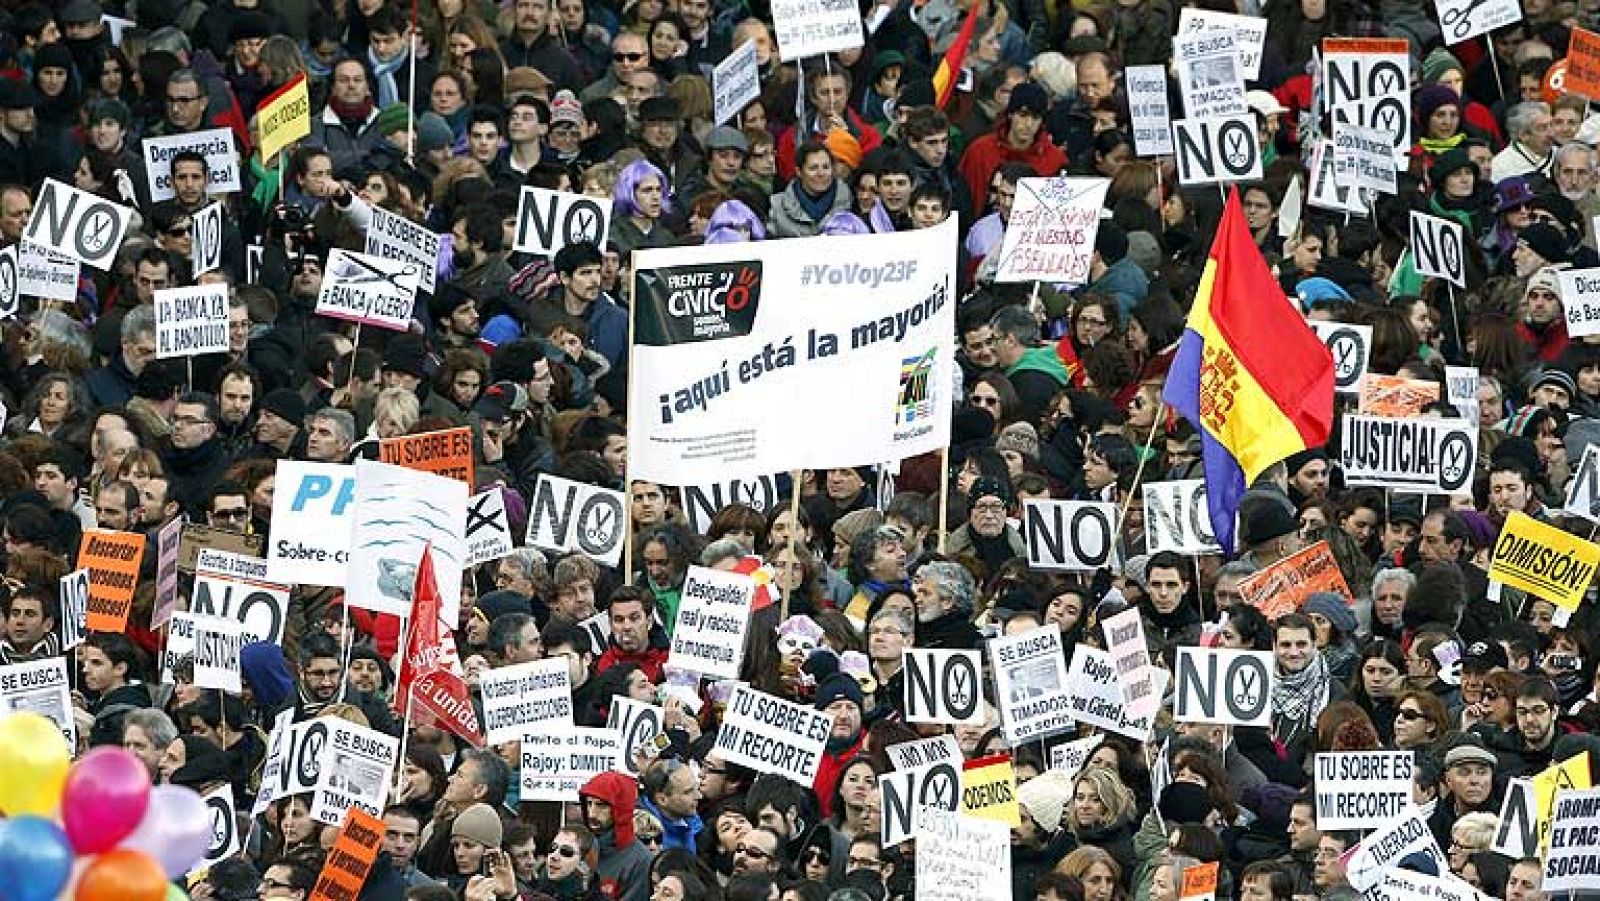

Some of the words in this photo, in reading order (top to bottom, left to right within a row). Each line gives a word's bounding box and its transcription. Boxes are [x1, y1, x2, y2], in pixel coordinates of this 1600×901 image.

[1198, 37, 1234, 53] BUSCA
[1190, 87, 1242, 105] TIMADOR
[1327, 60, 1405, 105] NO
[150, 138, 228, 163] Democracia
[1177, 120, 1256, 180] NO
[155, 166, 234, 189] ecica!
[28, 184, 122, 261] NO
[372, 208, 385, 231] TU
[387, 216, 422, 249] SOBRE
[425, 234, 438, 257] ES
[519, 192, 605, 250] NO
[194, 208, 220, 275] NO
[368, 236, 380, 256] MI
[1412, 216, 1461, 280] NO
[668, 273, 713, 288] FRENTE
[800, 259, 917, 288] #YoVoy23F
[331, 285, 366, 311] BANCA
[738, 336, 796, 385] está
[808, 330, 838, 359] la
[851, 274, 949, 349] mayoría!
[1569, 307, 1582, 323] de
[1327, 327, 1365, 387] O
[382, 443, 400, 464] TU
[404, 438, 448, 464] SOBRE
[450, 432, 470, 458] ES
[1343, 417, 1436, 474] JUSTICIA!
[530, 480, 624, 555] NO
[1027, 504, 1111, 566] NO
[1495, 531, 1592, 590] DIMISIÓN!
[194, 581, 282, 643] NO
[999, 647, 1012, 662] SE
[1018, 634, 1059, 658] BUSCA
[2, 674, 17, 690] SE
[21, 667, 63, 687] BUSCA
[905, 652, 978, 720] NO
[1178, 652, 1270, 720] NO
[733, 688, 755, 716] TU
[754, 697, 809, 735] SOBRE
[807, 715, 830, 743] ES
[1010, 696, 1068, 723] TIMADOR
[333, 729, 349, 747] SE
[352, 735, 394, 760] BUSCA
[567, 735, 578, 746] al
[608, 700, 658, 773] NO
[718, 723, 740, 751] MI
[1014, 725, 1032, 737] en
[523, 753, 566, 775] Rajoy:
[570, 755, 615, 771] DIMITE
[1319, 755, 1336, 780] TU
[1340, 755, 1390, 780] SOBRE
[1394, 754, 1411, 780] ES
[882, 762, 959, 844] NO
[962, 778, 1014, 811] ODEMOS.
[1319, 792, 1334, 818] MI
[1337, 792, 1407, 818] RECORTE
[320, 810, 338, 823] en
[1552, 828, 1565, 848] EL
[1568, 825, 1600, 848] PAC
